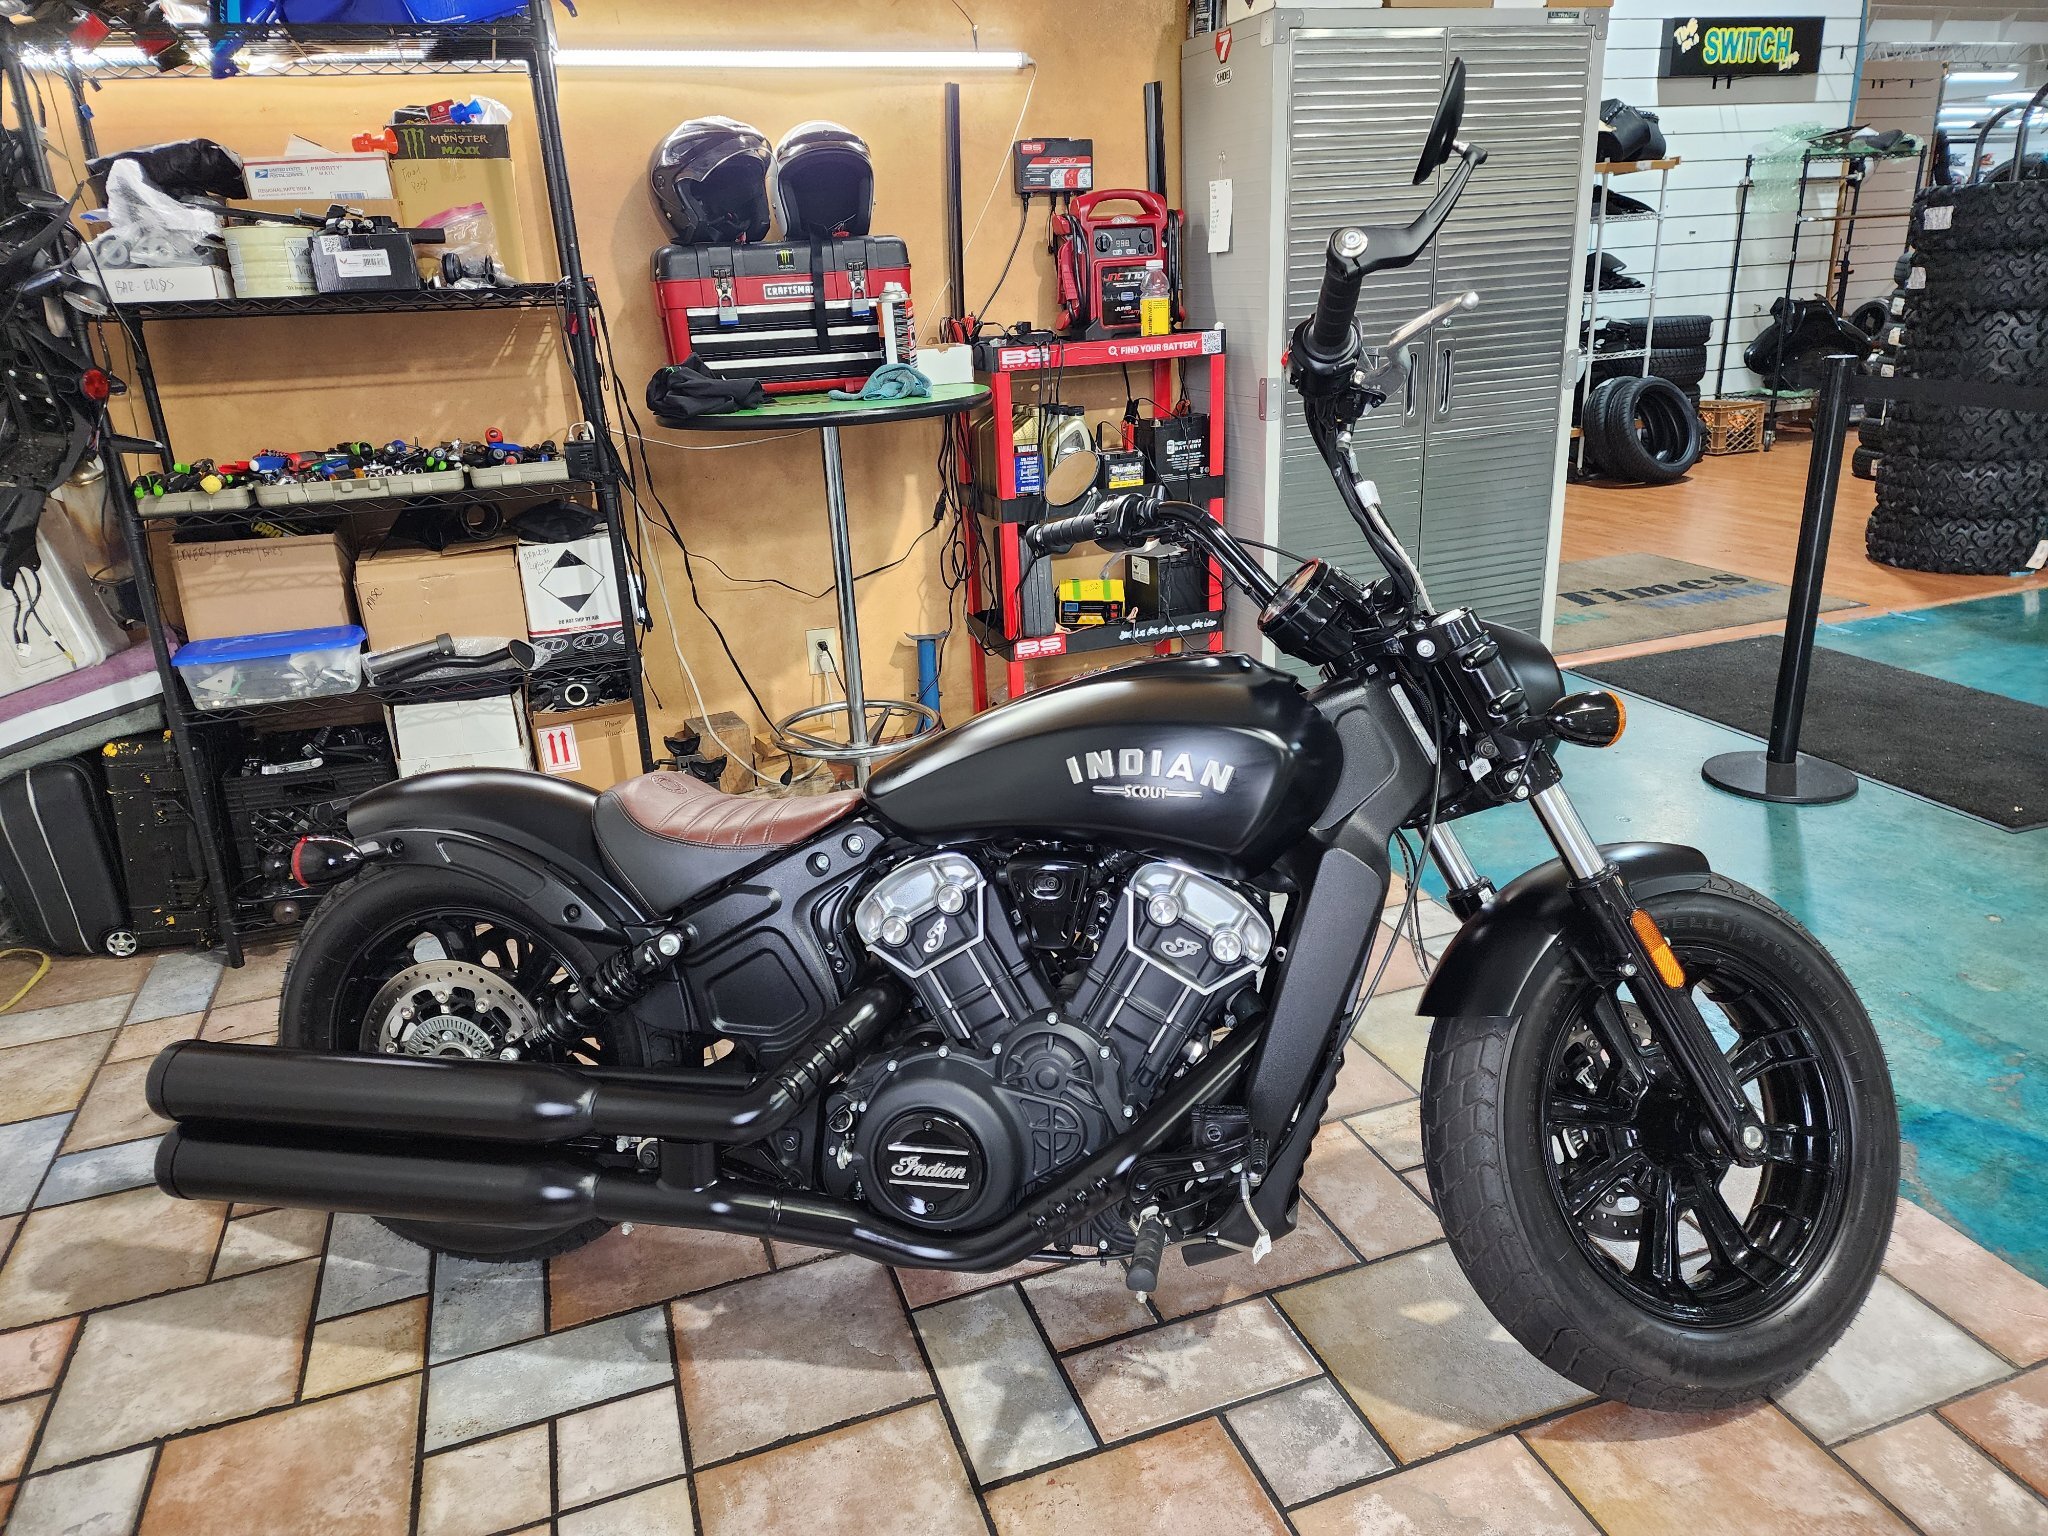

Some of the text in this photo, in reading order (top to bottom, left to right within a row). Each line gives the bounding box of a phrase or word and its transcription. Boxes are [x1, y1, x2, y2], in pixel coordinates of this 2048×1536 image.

[1219, 33, 1231, 61] 7
[1702, 27, 1793, 64] SWITCH
[430, 133, 489, 145] MONSTER
[441, 146, 481, 155] MAXX
[1120, 340, 1199, 355] FIND YOUR BATTERY
[1001, 348, 1049, 365] BS
[1016, 637, 1062, 655] BS
[1066, 748, 1236, 794] INDIAN
[1124, 784, 1168, 799] SCOUT
[890, 1155, 967, 1180] Indian
